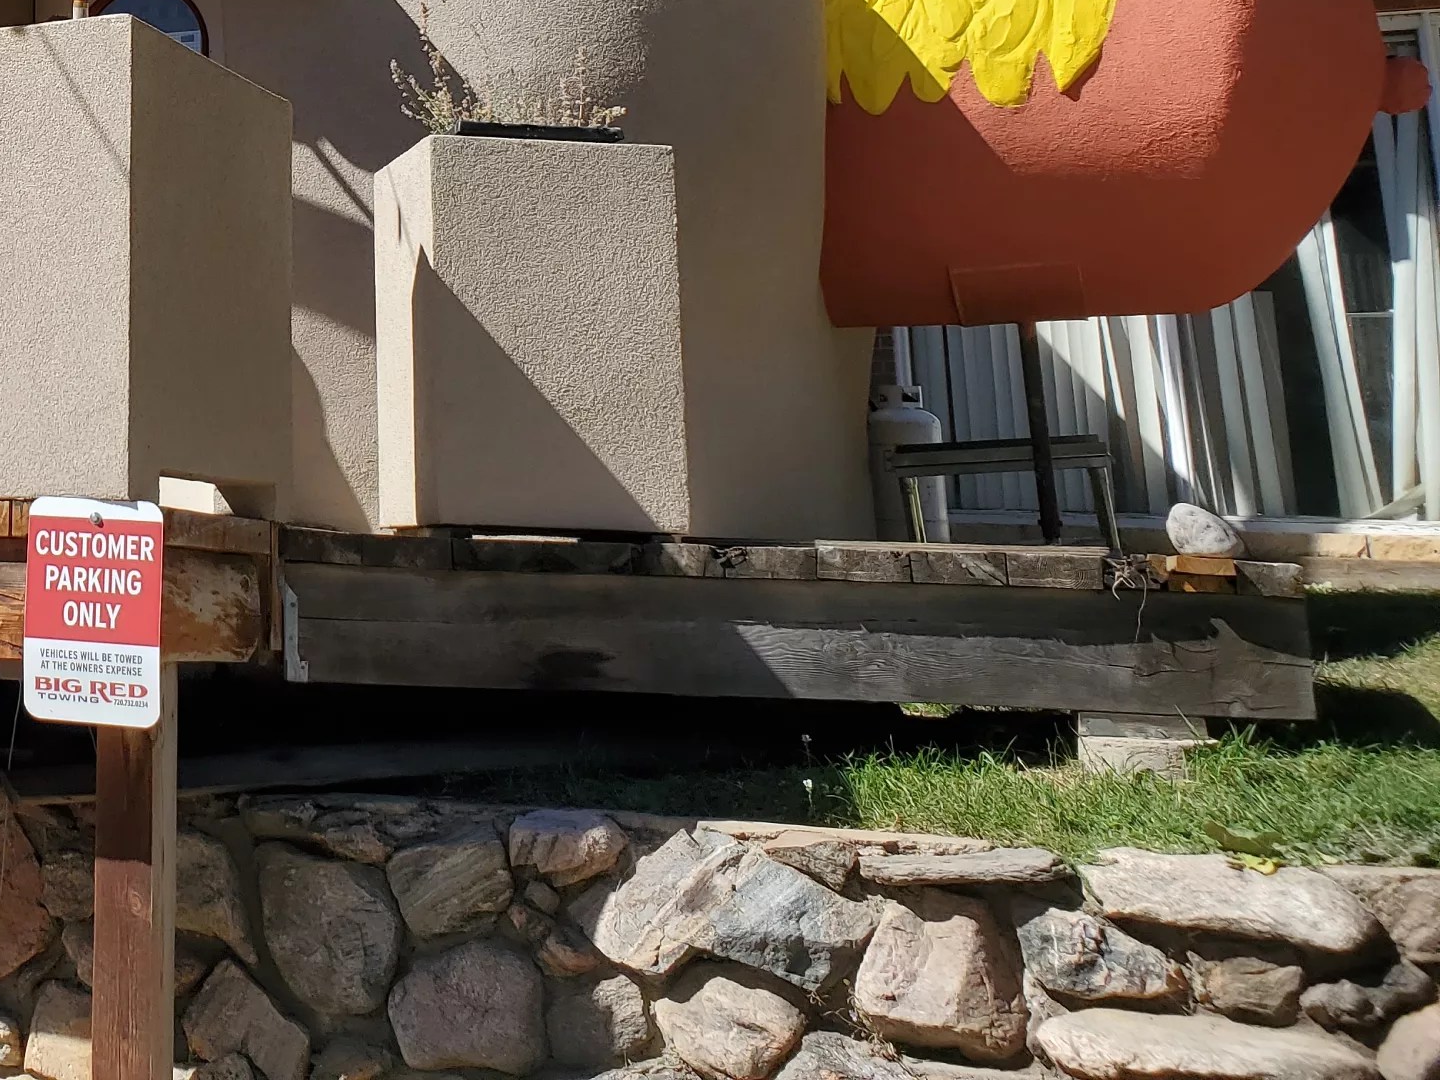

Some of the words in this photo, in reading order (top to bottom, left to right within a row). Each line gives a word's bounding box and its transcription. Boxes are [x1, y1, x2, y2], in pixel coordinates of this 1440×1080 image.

[35, 529, 155, 562] CUSTOMER
[45, 564, 142, 595] PARKING
[63, 600, 122, 629] ONLY
[40, 648, 78, 660] VEHICLES
[80, 651, 100, 662] WILL
[101, 653, 112, 663] BE
[114, 653, 143, 665] TOWED
[40, 660, 51, 670] AT
[52, 661, 68, 671] THE
[70, 662, 104, 674] OWNERS
[106, 664, 143, 677] EXPENSE
[34, 675, 82, 694] BIG
[89, 680, 149, 703] RED
[37, 691, 100, 704] TOWING
